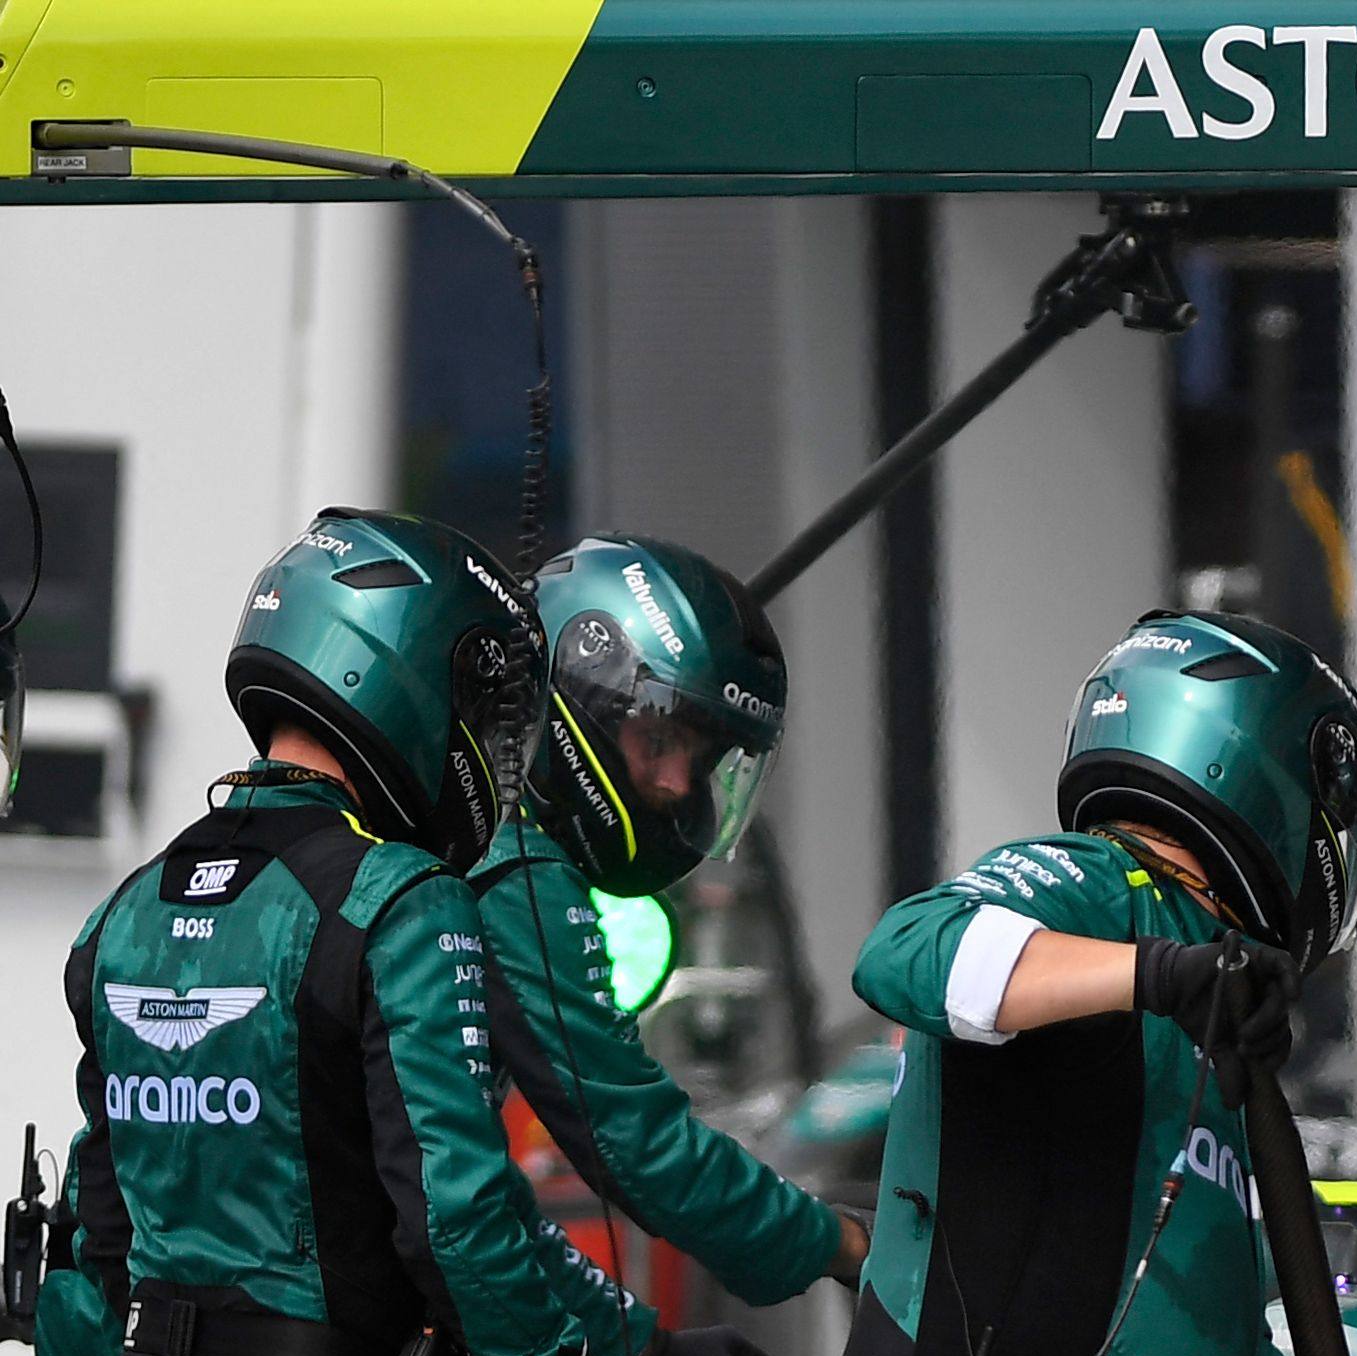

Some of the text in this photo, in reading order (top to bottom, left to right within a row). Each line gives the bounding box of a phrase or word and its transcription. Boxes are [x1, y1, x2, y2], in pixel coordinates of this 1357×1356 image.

[63, 158, 84, 167] JACK
[551, 720, 582, 771] ASTON
[575, 769, 619, 828] MARTIN
[188, 863, 237, 891] OMP
[172, 918, 214, 938] BOSS
[140, 1001, 176, 1019] ASTON
[105, 1074, 260, 1125] aramco
